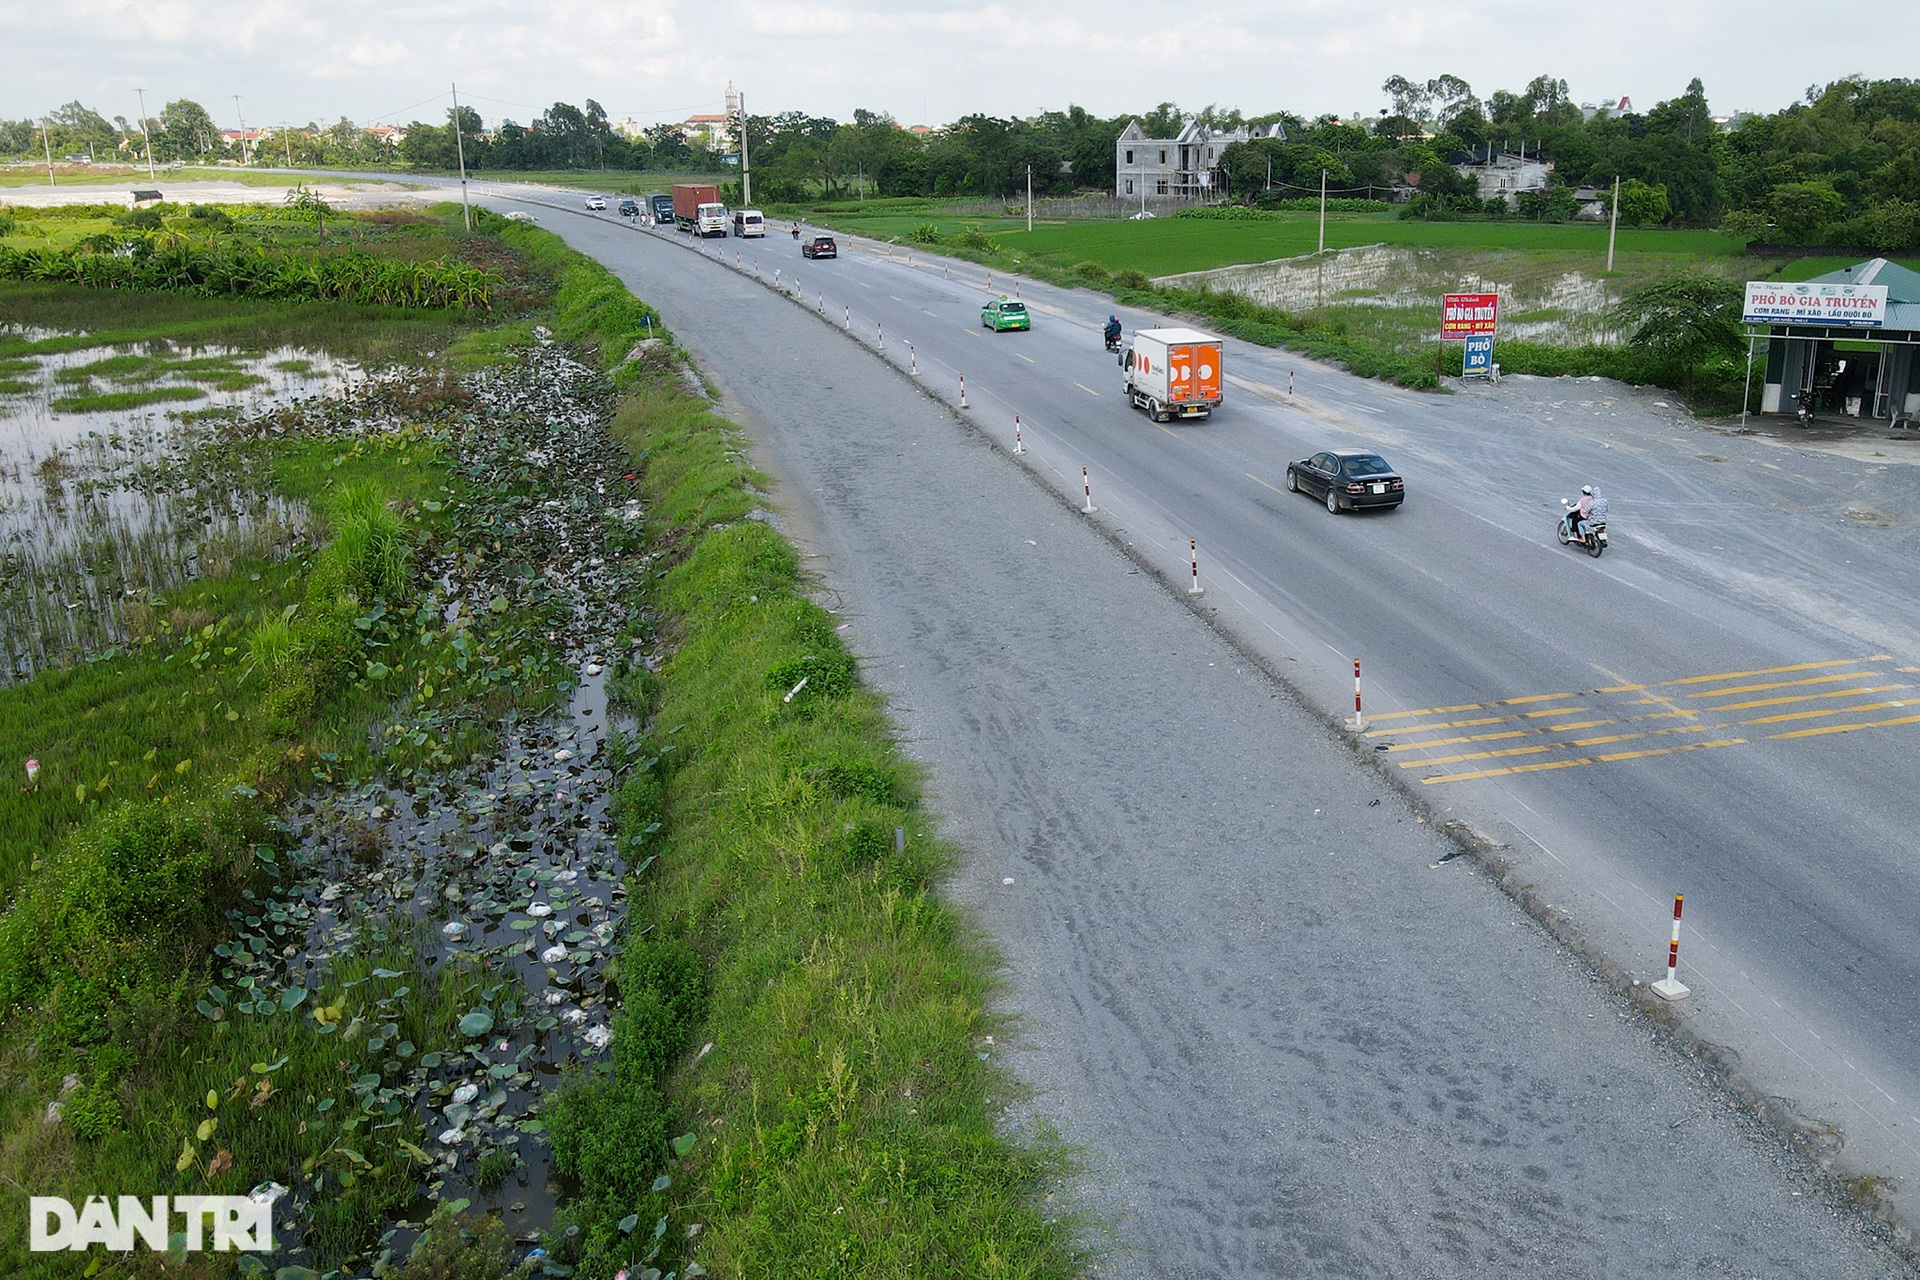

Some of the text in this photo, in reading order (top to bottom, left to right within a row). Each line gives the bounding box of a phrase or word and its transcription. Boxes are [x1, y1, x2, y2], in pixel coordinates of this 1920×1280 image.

[1751, 291, 1776, 305] PHỞ
[1779, 293, 1796, 306] BÒ
[1799, 296, 1822, 307] GIA
[1468, 337, 1491, 352] PHỞ
[1470, 353, 1486, 366] BÒ
